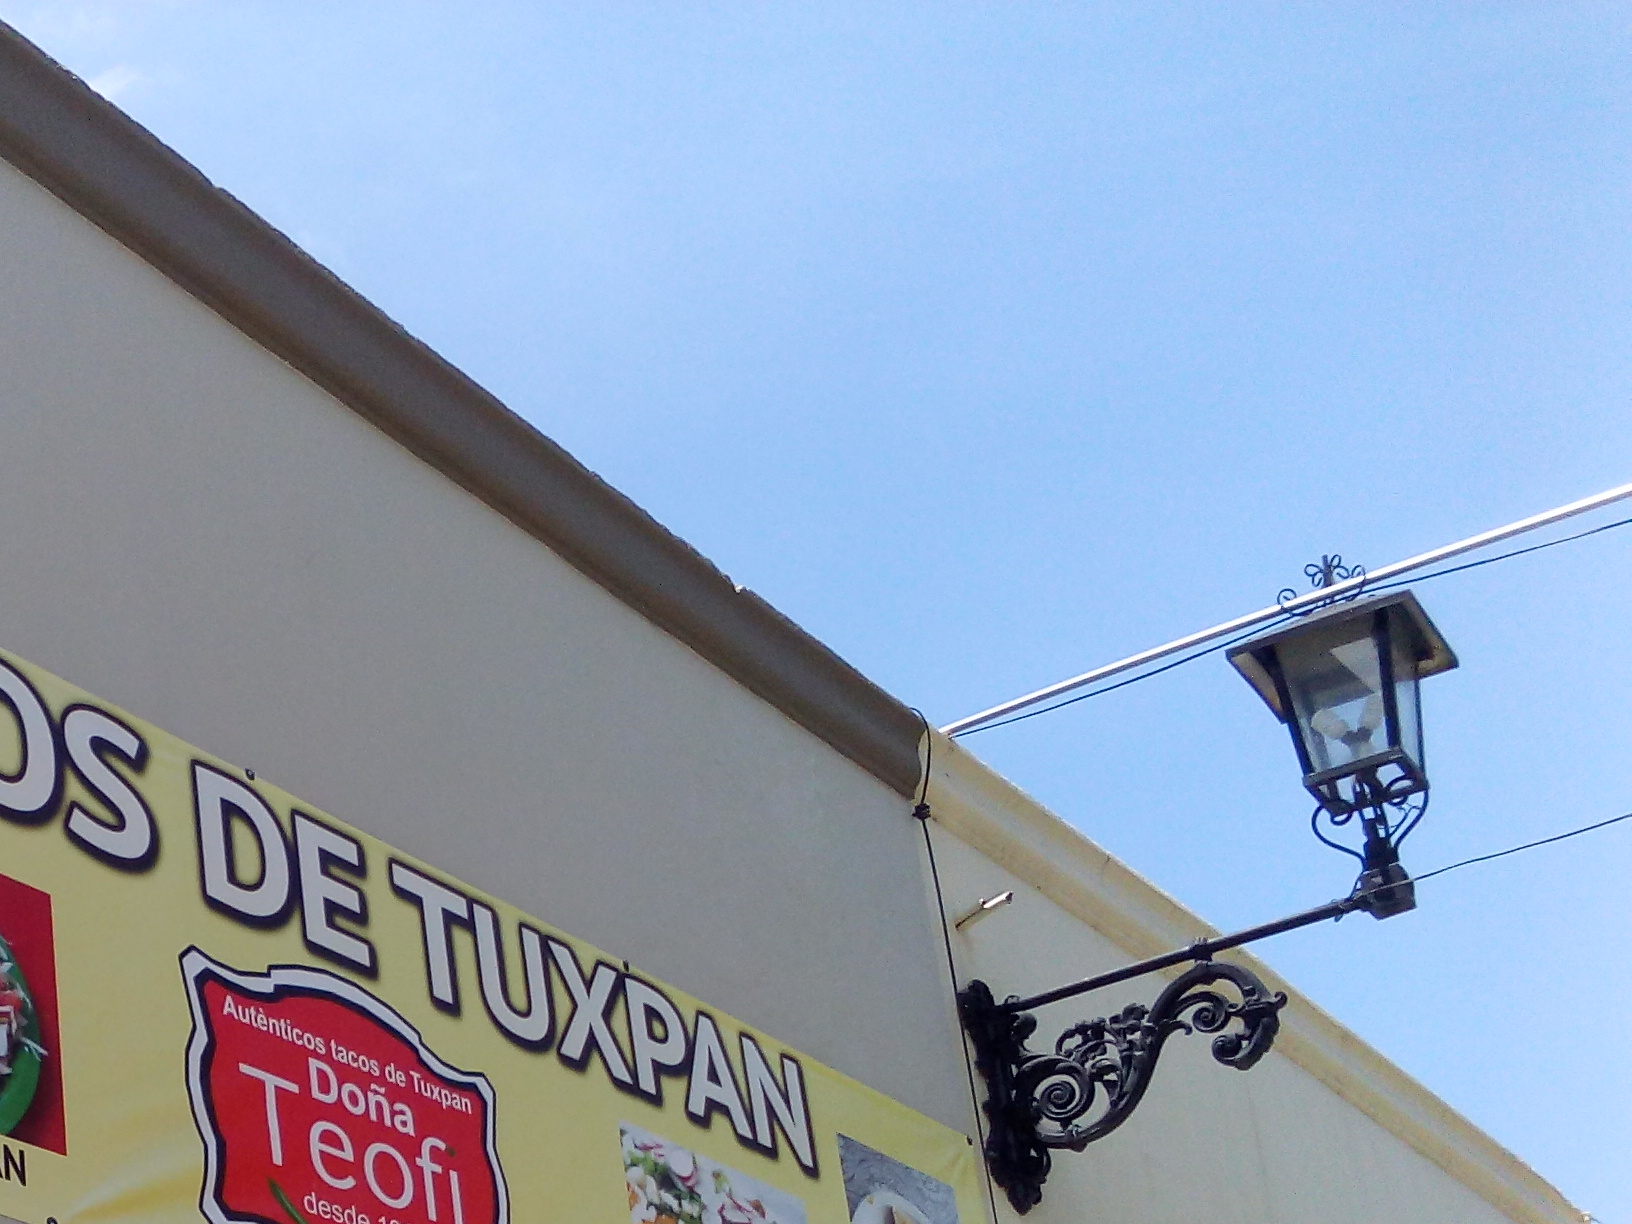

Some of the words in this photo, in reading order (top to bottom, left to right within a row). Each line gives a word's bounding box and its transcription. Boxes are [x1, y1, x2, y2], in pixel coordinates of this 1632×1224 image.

[191, 759, 377, 980] DE
[389, 857, 819, 1178] TUXPAN
[308, 1057, 416, 1137] Doña
[330, 1038, 380, 1078] tacos
[384, 1062, 406, 1088] de
[410, 1070, 473, 1115] Tuxpan
